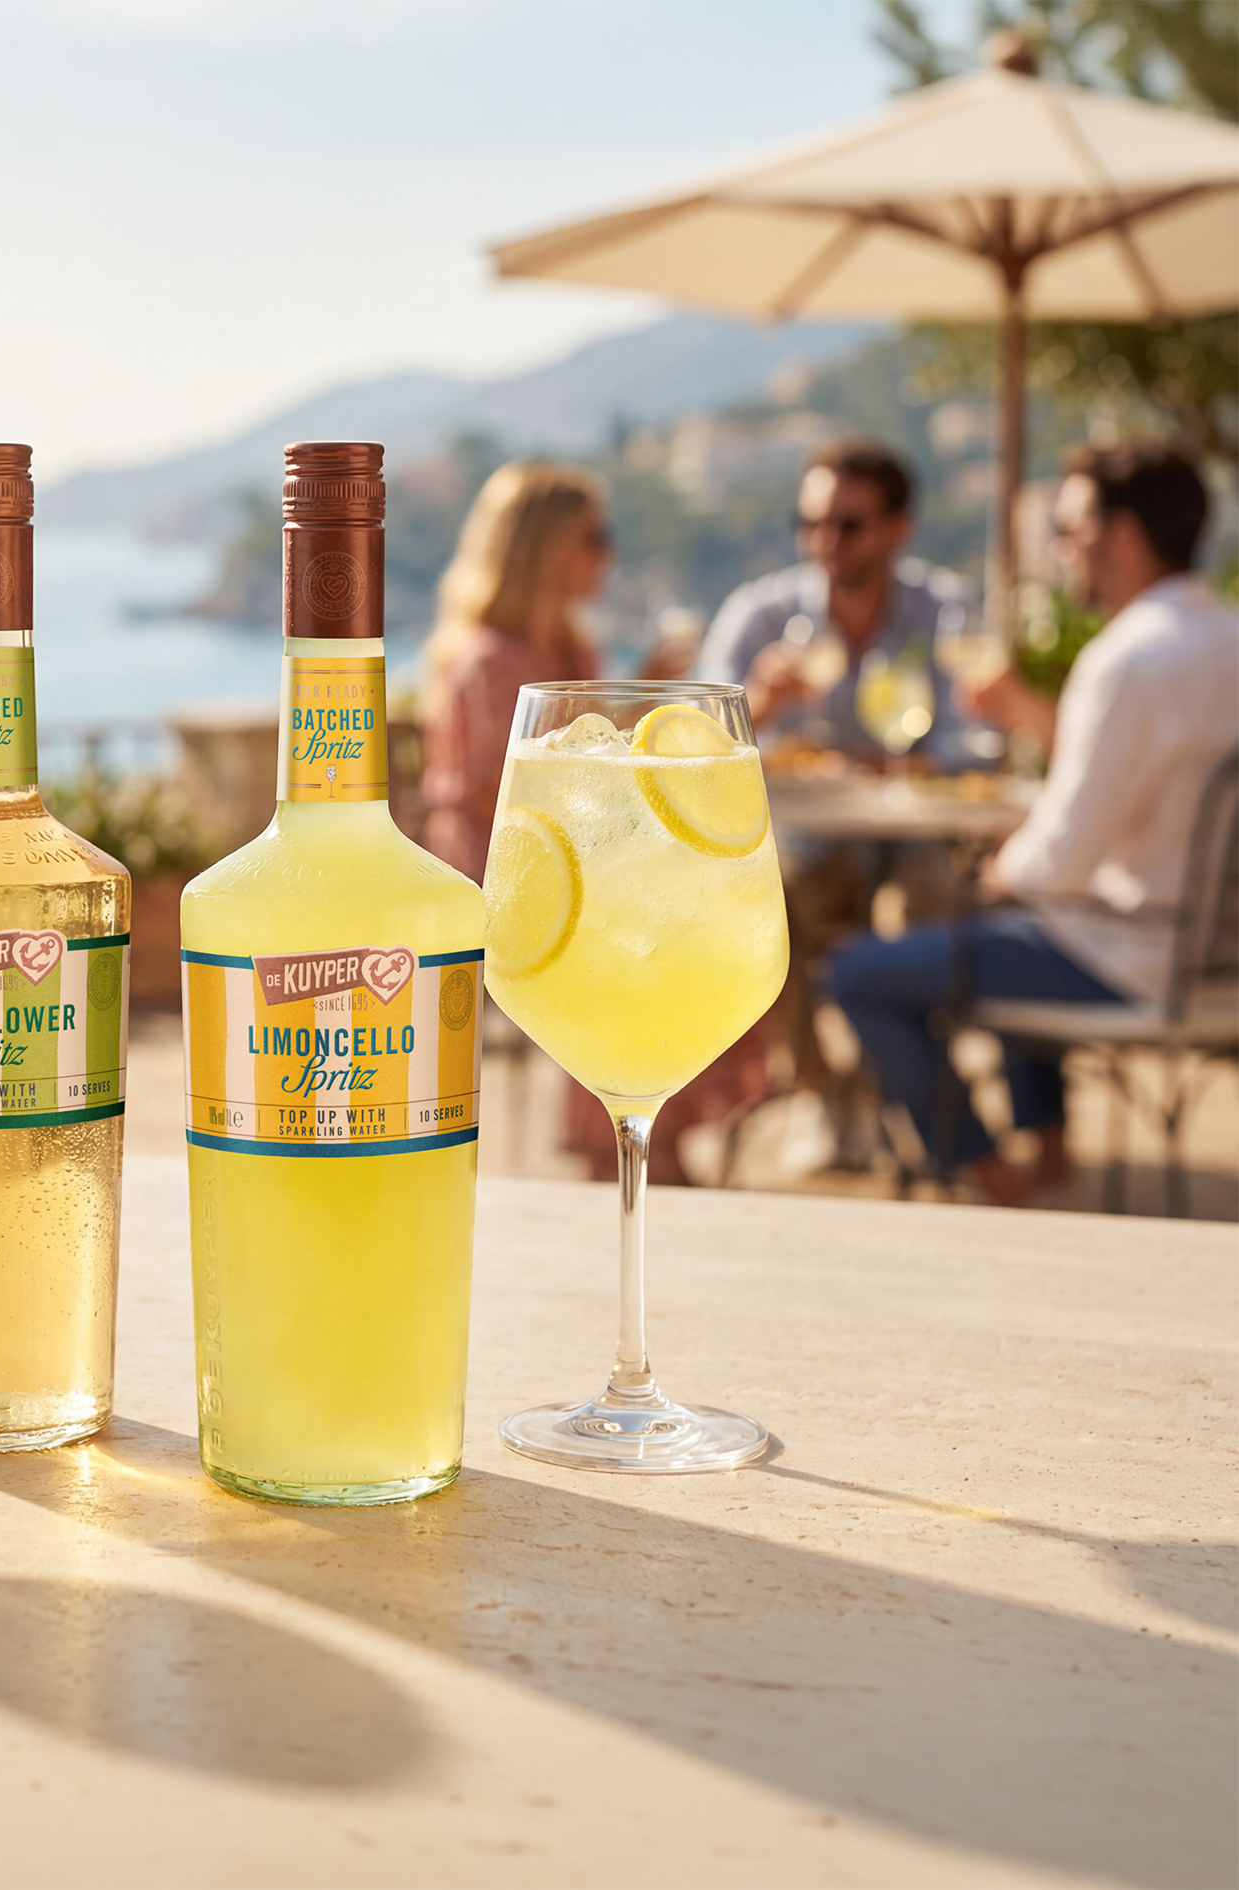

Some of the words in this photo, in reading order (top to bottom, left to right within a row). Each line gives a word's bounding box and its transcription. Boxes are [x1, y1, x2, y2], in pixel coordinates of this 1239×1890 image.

[296, 684, 320, 698] BAR
[327, 685, 366, 698] READY
[292, 707, 374, 730] BATCHED
[292, 728, 365, 765] Spritz
[0, 973, 19, 991] 1695
[266, 974, 281, 987] DE
[283, 956, 360, 994] KUYPER
[319, 995, 345, 1011] SINCE
[348, 992, 368, 1011] 1695
[248, 1025, 415, 1057] LIMONCELLO
[281, 1054, 379, 1098] Spritz
[68, 1085, 79, 1097] 10
[81, 1080, 111, 1096] SERVES
[1, 1098, 36, 1109] WATER
[279, 1109, 308, 1124] TOP
[317, 1110, 337, 1124] UP
[346, 1108, 386, 1124] WITH
[419, 1110, 430, 1123] 10
[433, 1105, 464, 1121] SERVES
[279, 1125, 343, 1137] SPARKLING
[349, 1124, 386, 1135] WATER
